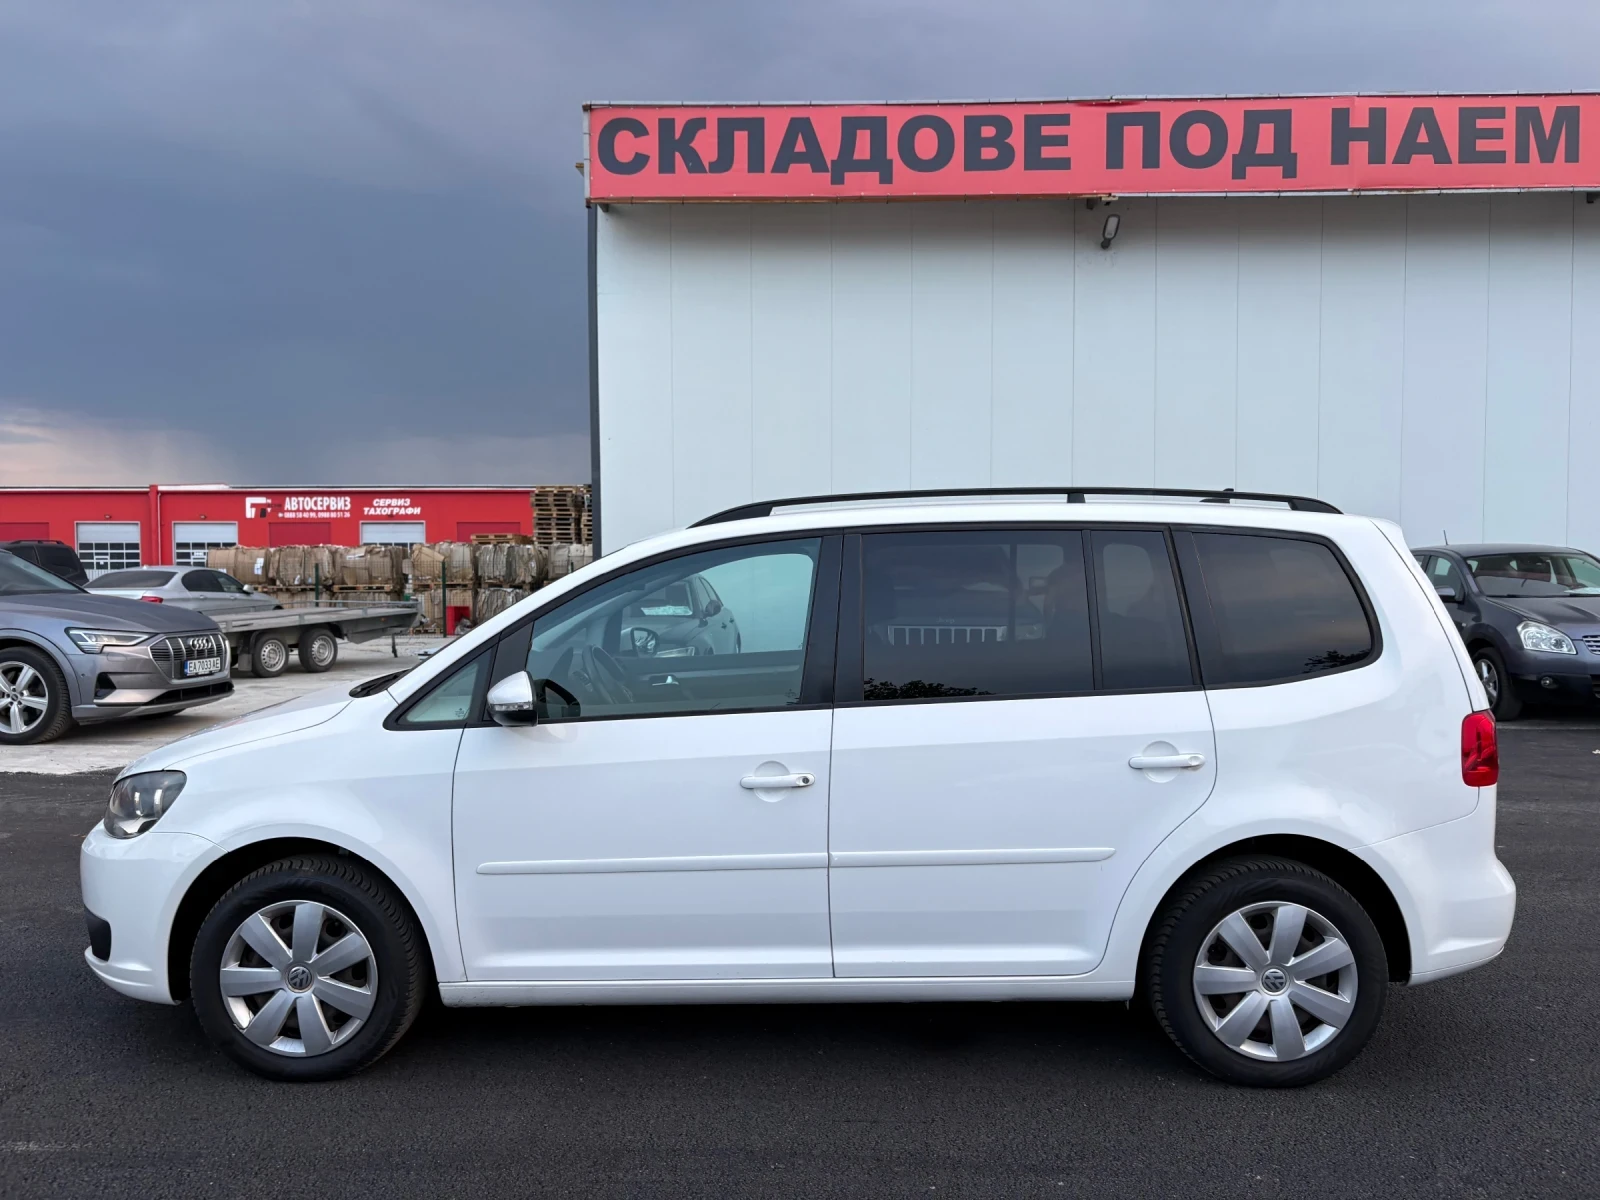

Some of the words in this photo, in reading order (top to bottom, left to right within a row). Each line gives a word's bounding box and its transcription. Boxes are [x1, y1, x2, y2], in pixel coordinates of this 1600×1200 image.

[597, 113, 1072, 186] СКЛАДОВЕ
[1105, 108, 1298, 180] ПОД
[1329, 105, 1581, 166] НАЕМ
[284, 496, 351, 511] АВТОСЕРВИЗ
[373, 498, 411, 507] СЕРВИЗ
[363, 506, 421, 515] ТАХОГРАФИ
